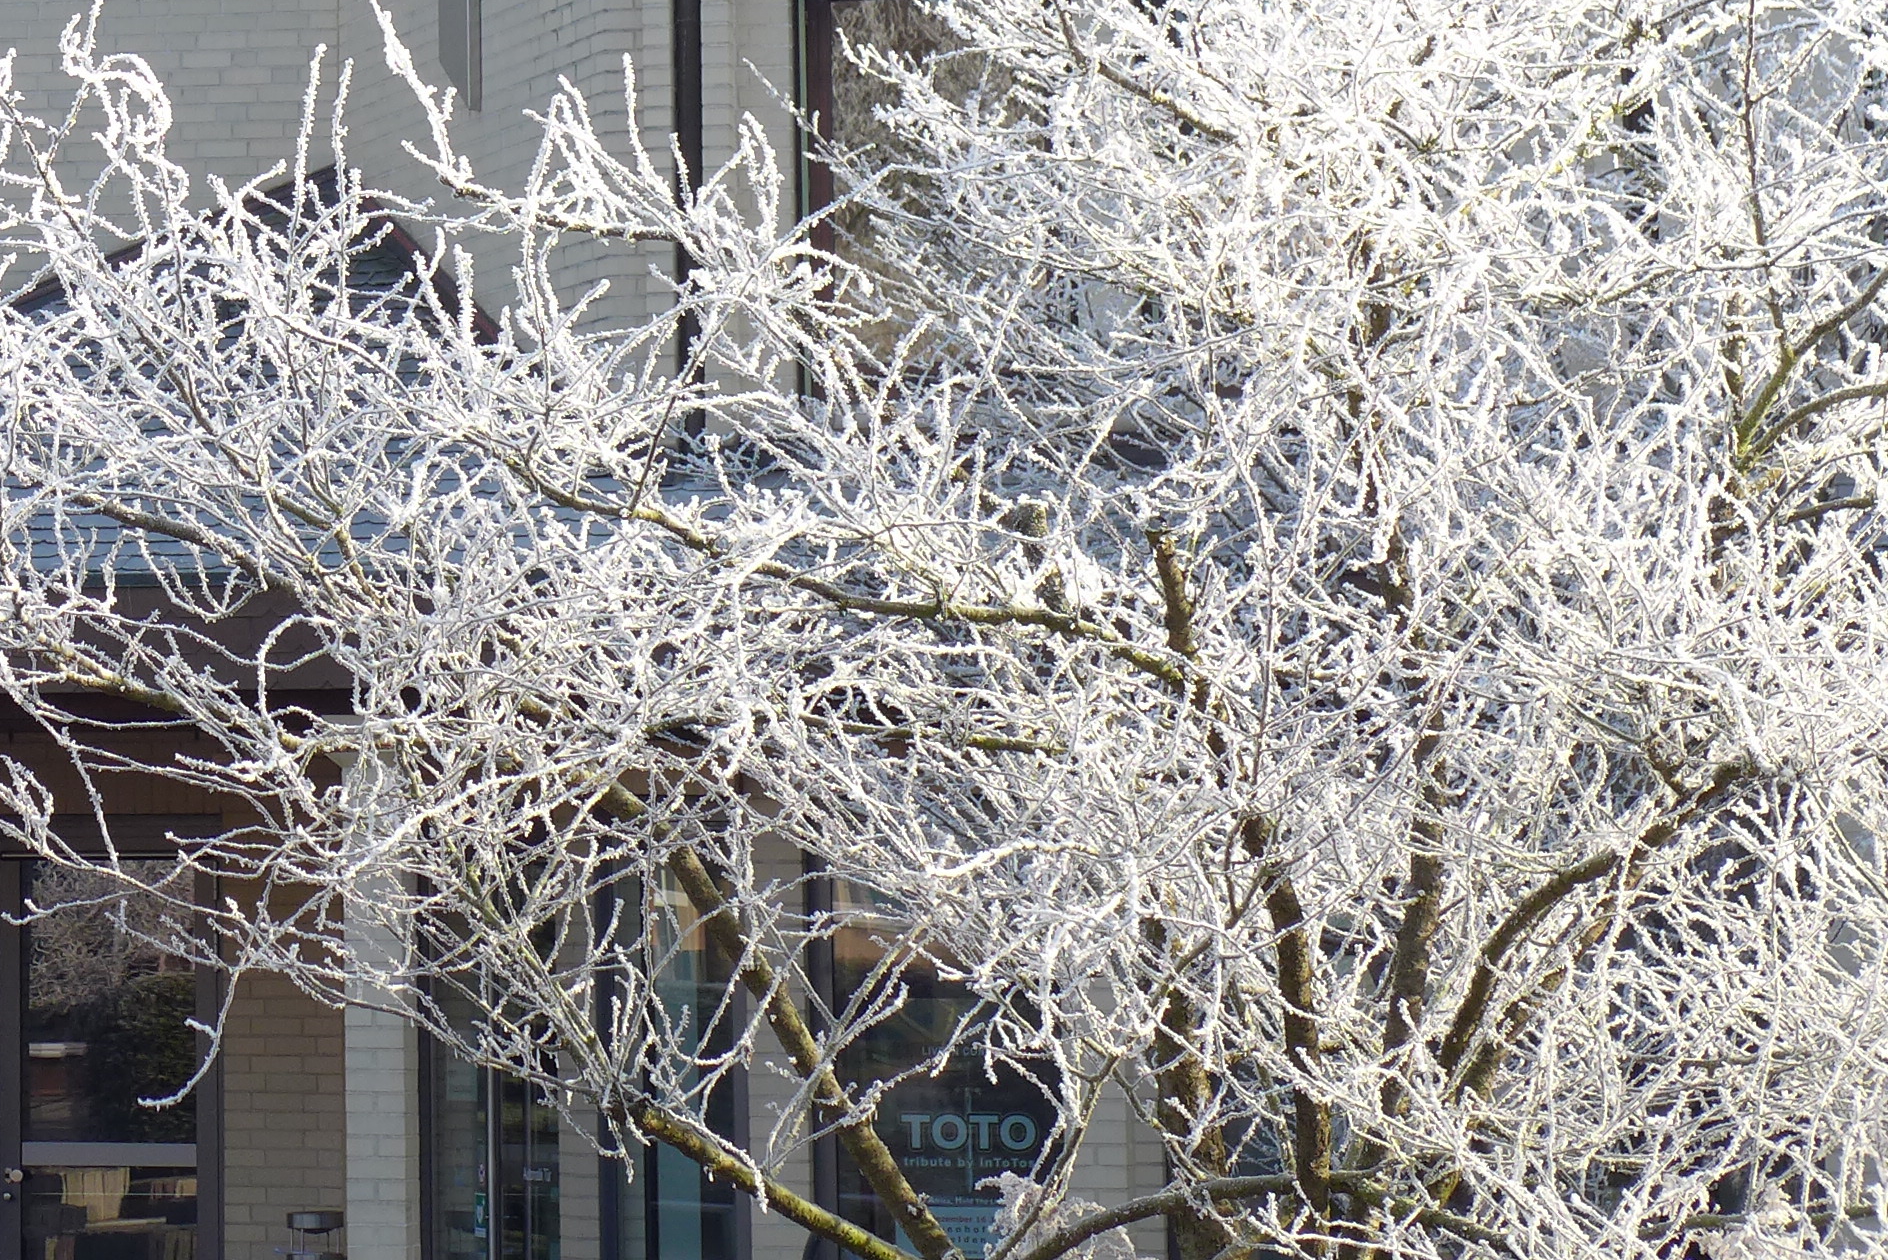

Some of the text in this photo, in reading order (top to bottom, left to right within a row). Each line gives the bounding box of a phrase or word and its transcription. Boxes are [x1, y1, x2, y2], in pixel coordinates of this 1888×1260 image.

[900, 1113, 1037, 1150] TOTO
[904, 1156, 952, 1167] tribute
[957, 1157, 974, 1169] by
